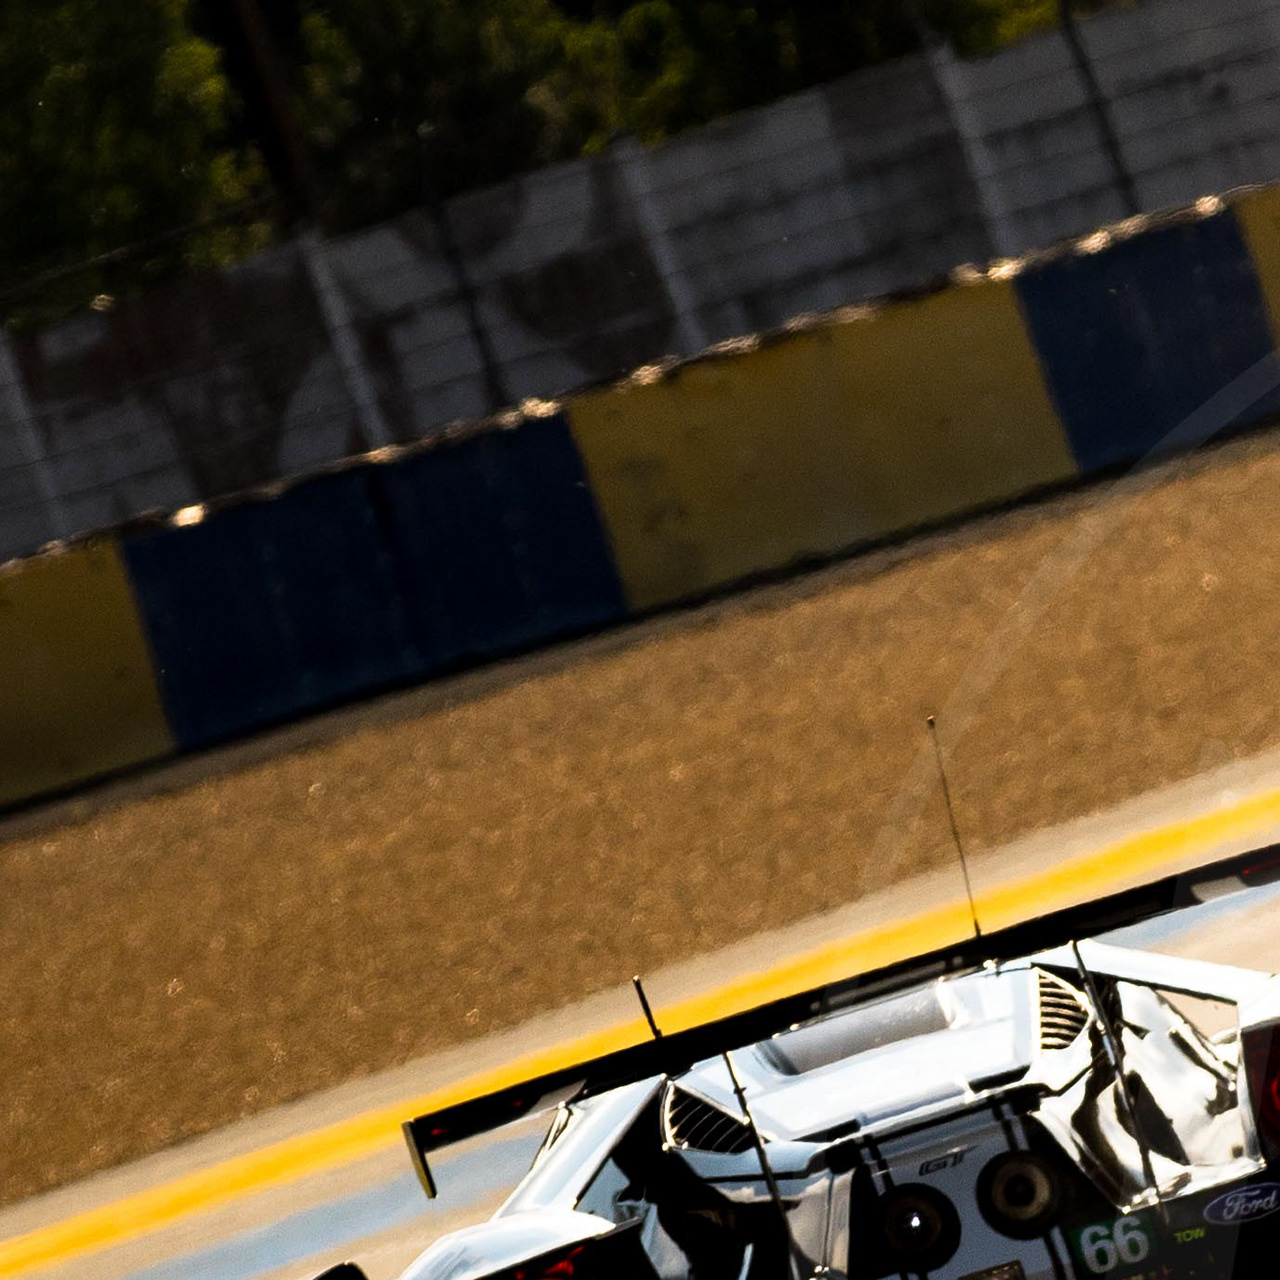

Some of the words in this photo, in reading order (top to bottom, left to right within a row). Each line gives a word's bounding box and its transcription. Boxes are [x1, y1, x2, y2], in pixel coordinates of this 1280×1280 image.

[1222, 1187, 1278, 1220] Ford
[1079, 1216, 1149, 1274] 66
[1174, 1228, 1206, 1245] TOW
